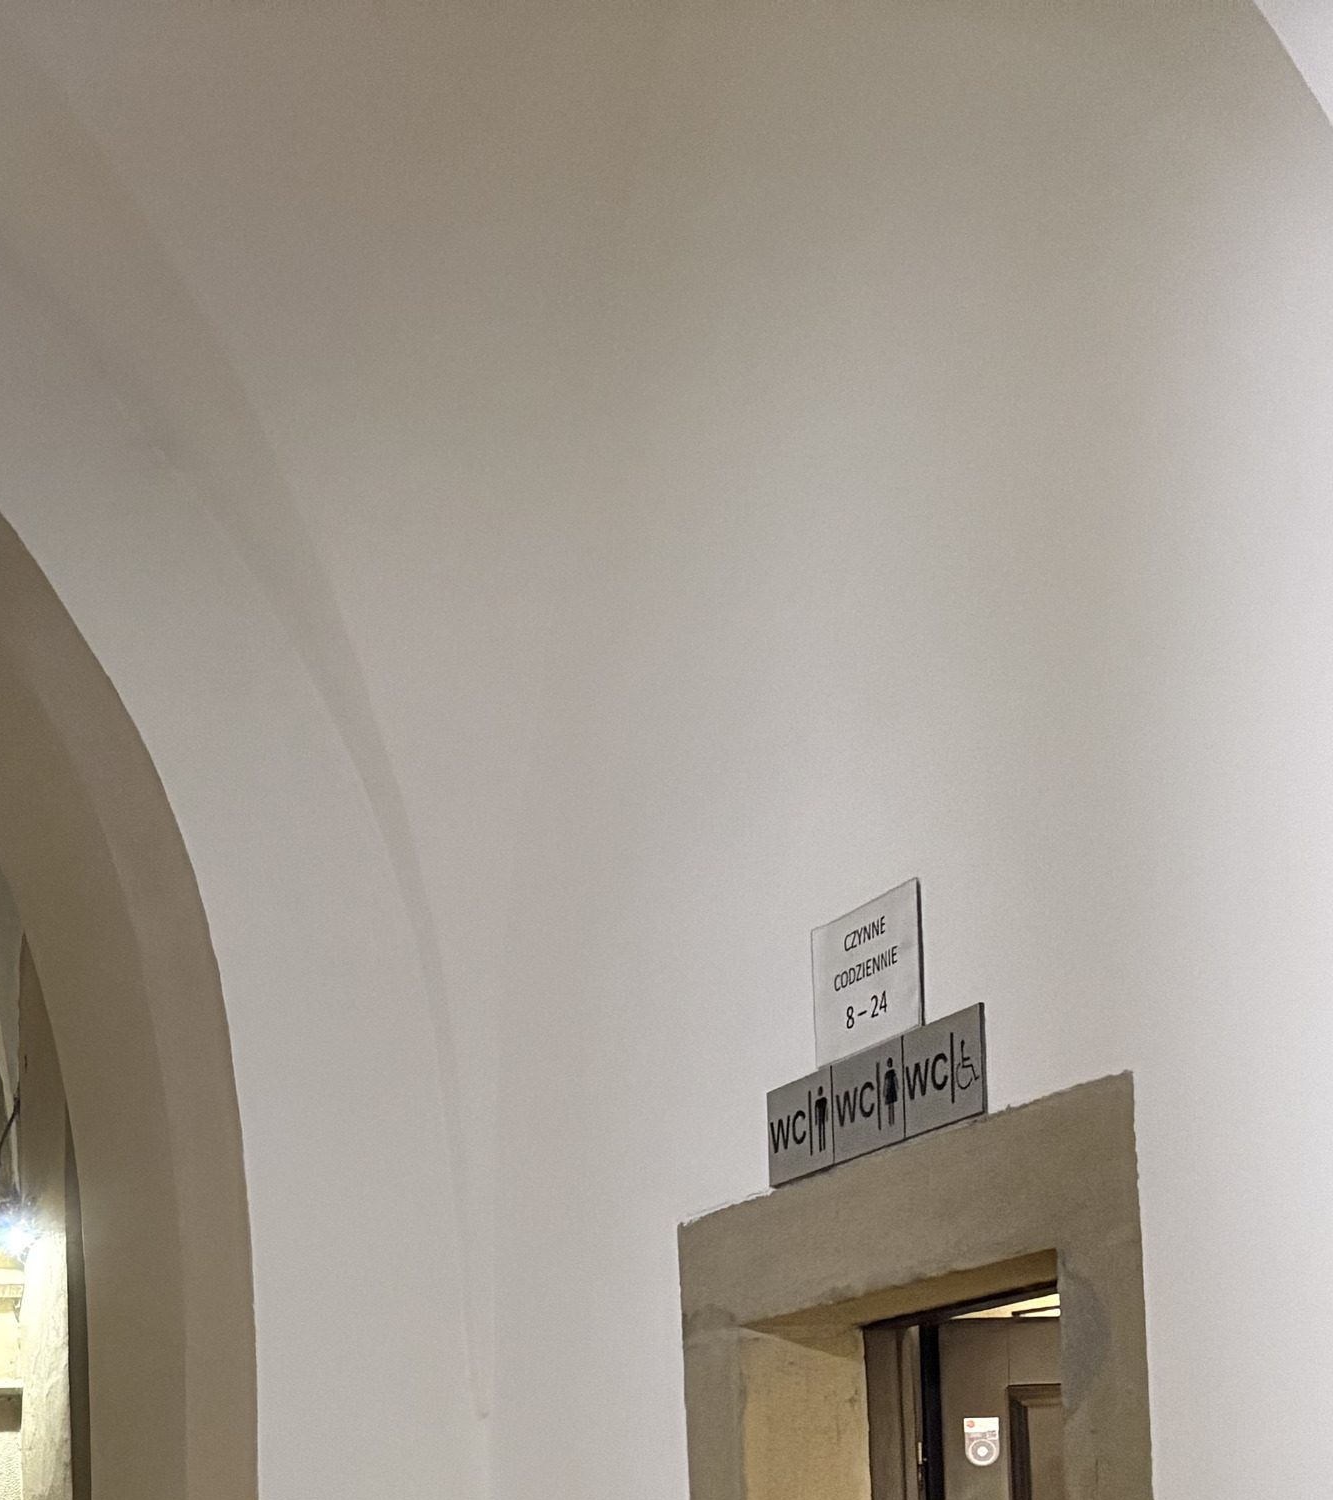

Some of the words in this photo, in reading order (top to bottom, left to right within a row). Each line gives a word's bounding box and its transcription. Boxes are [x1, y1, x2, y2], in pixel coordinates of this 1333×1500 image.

[844, 915, 886, 952] CZYNNE
[834, 945, 898, 992] CODZIENNIE
[770, 1110, 807, 1154] WC
[836, 1081, 875, 1127] WC
[905, 1053, 948, 1101] WC
